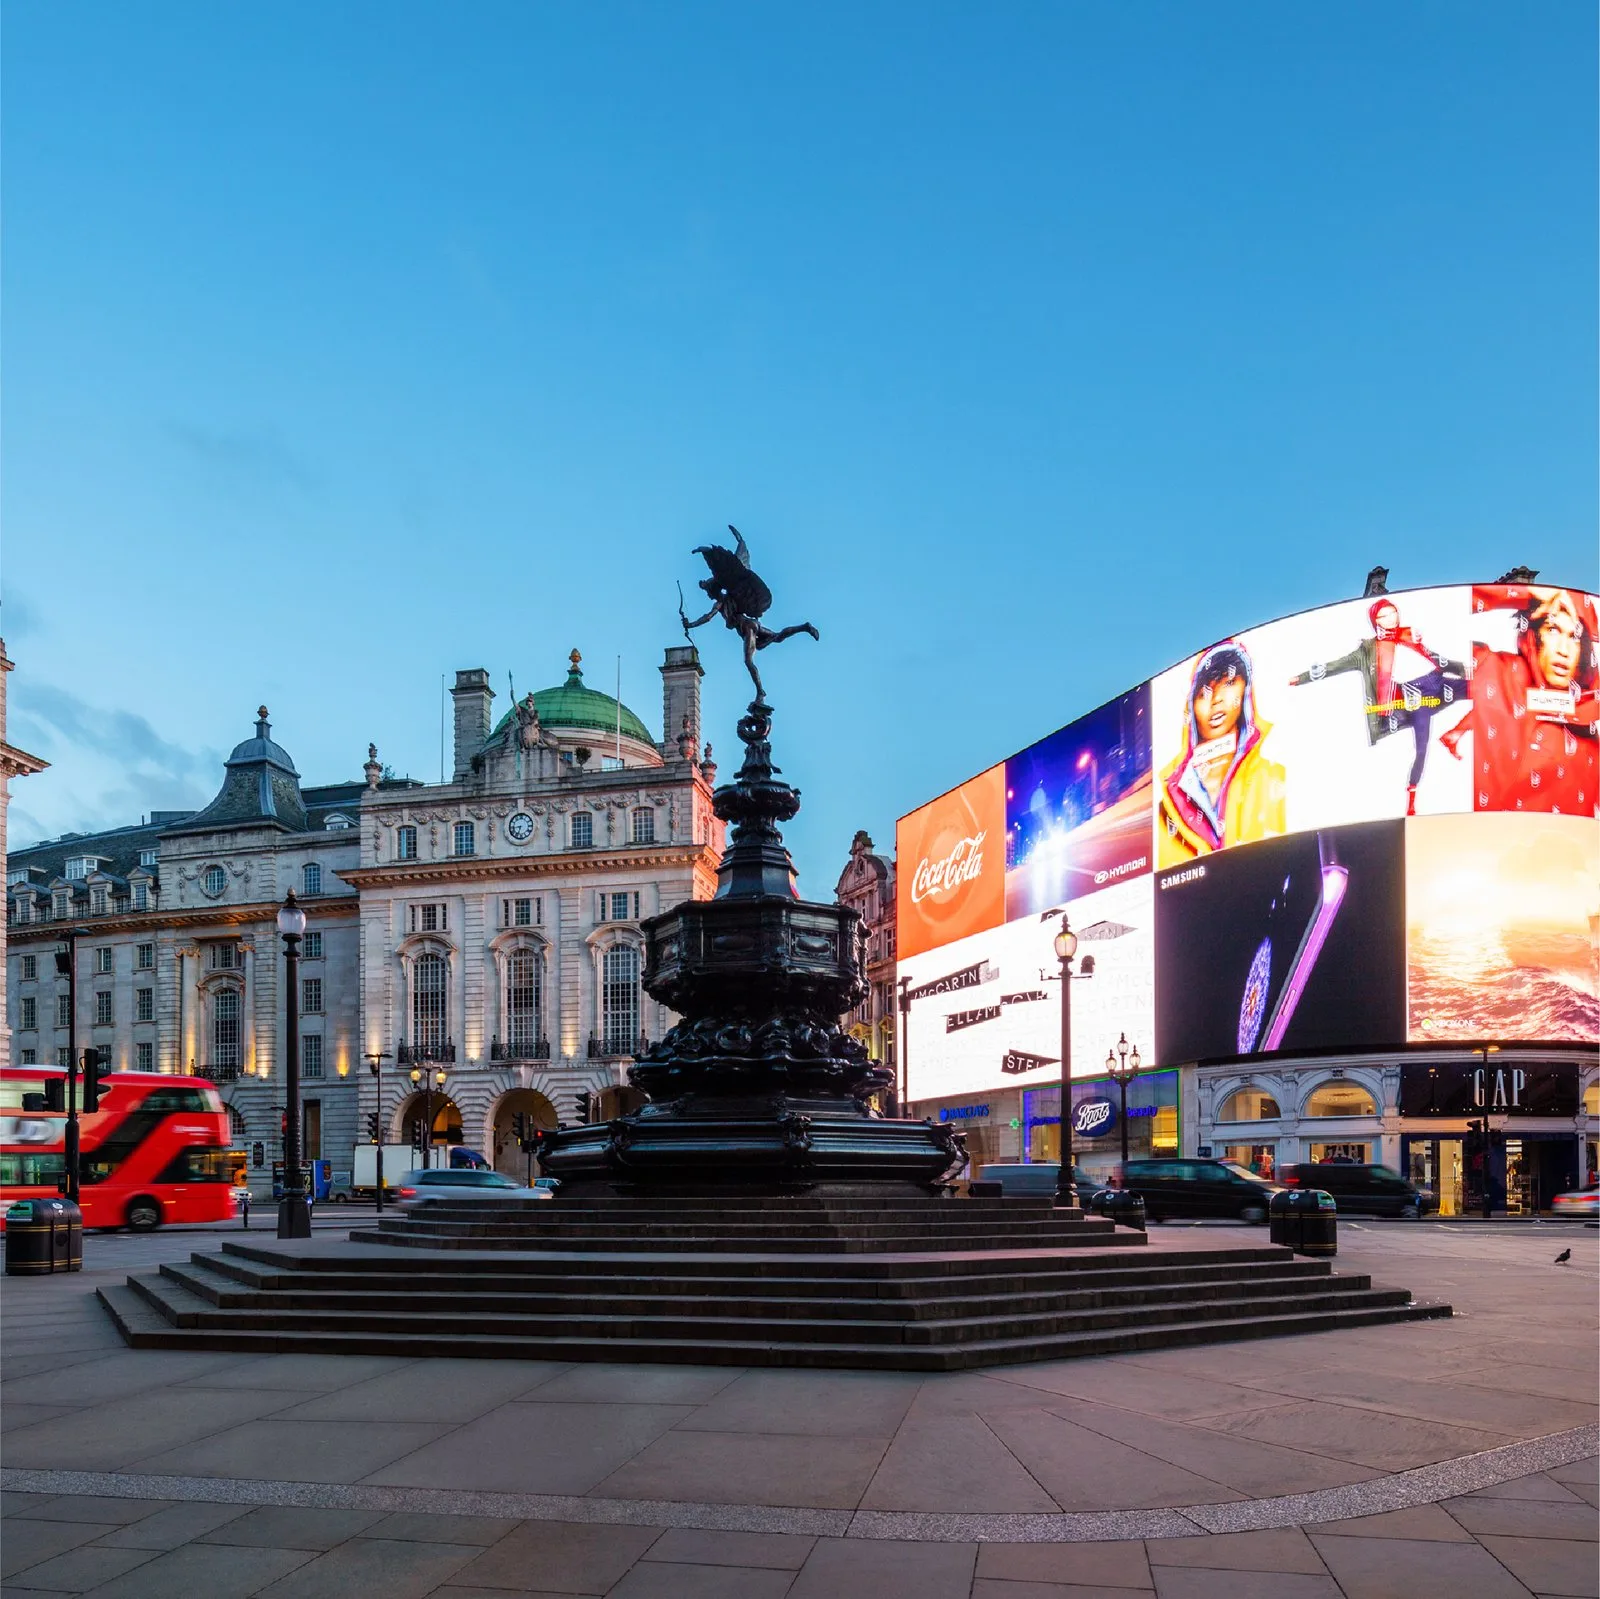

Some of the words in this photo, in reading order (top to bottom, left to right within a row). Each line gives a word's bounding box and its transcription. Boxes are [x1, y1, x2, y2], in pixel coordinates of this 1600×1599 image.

[1110, 856, 1147, 878] HYUNDAI
[1161, 865, 1206, 889] SAMSUNG
[1474, 1068, 1525, 1107] GAP
[949, 1104, 990, 1120] BARCLAYS
[1075, 1102, 1110, 1131] Boots
[1127, 1105, 1158, 1118] beauty
